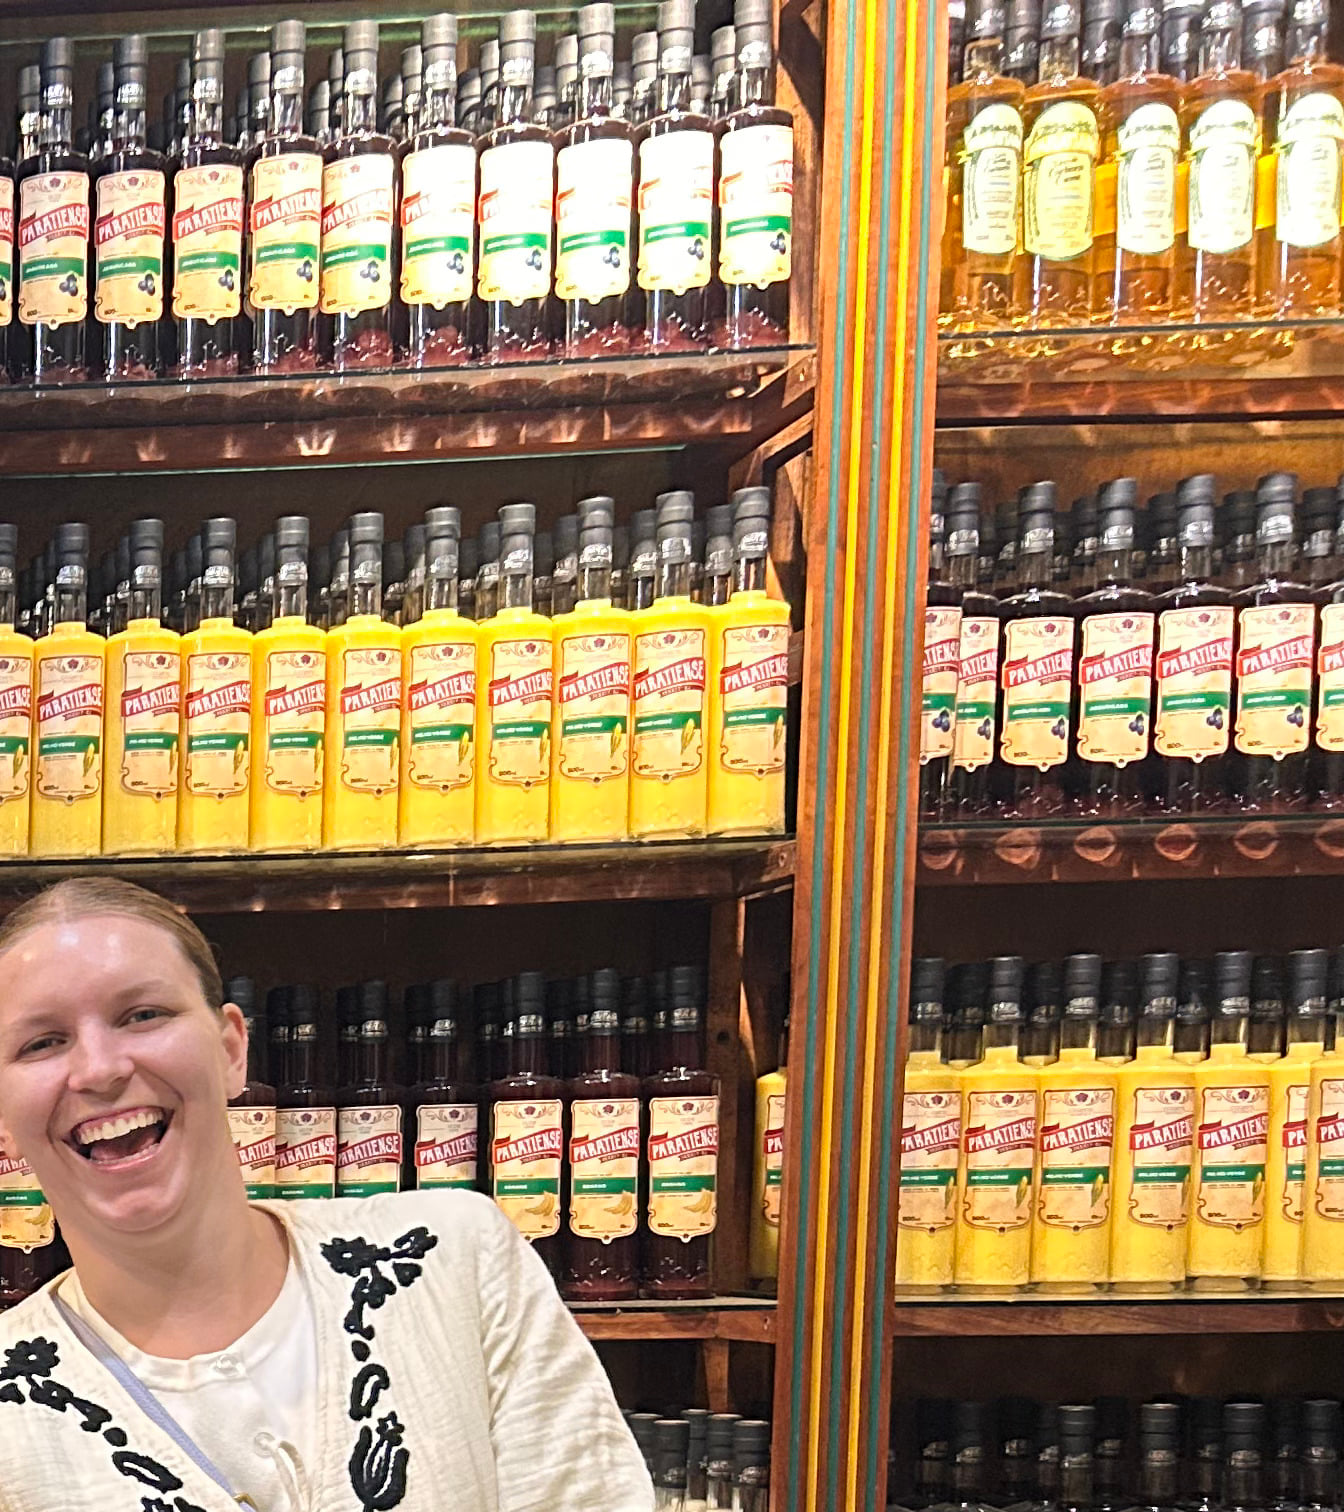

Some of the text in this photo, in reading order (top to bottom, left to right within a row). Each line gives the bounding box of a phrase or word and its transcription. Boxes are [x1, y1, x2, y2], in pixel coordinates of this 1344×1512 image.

[561, 663, 629, 702] PARATIENSE
[634, 658, 704, 700] PARATIENSE
[39, 684, 103, 719] PARATIENSE
[497, 1130, 560, 1160] PARATIENSE
[573, 1130, 638, 1162] PARATIENSE
[651, 1127, 717, 1160] PARATIENSE
